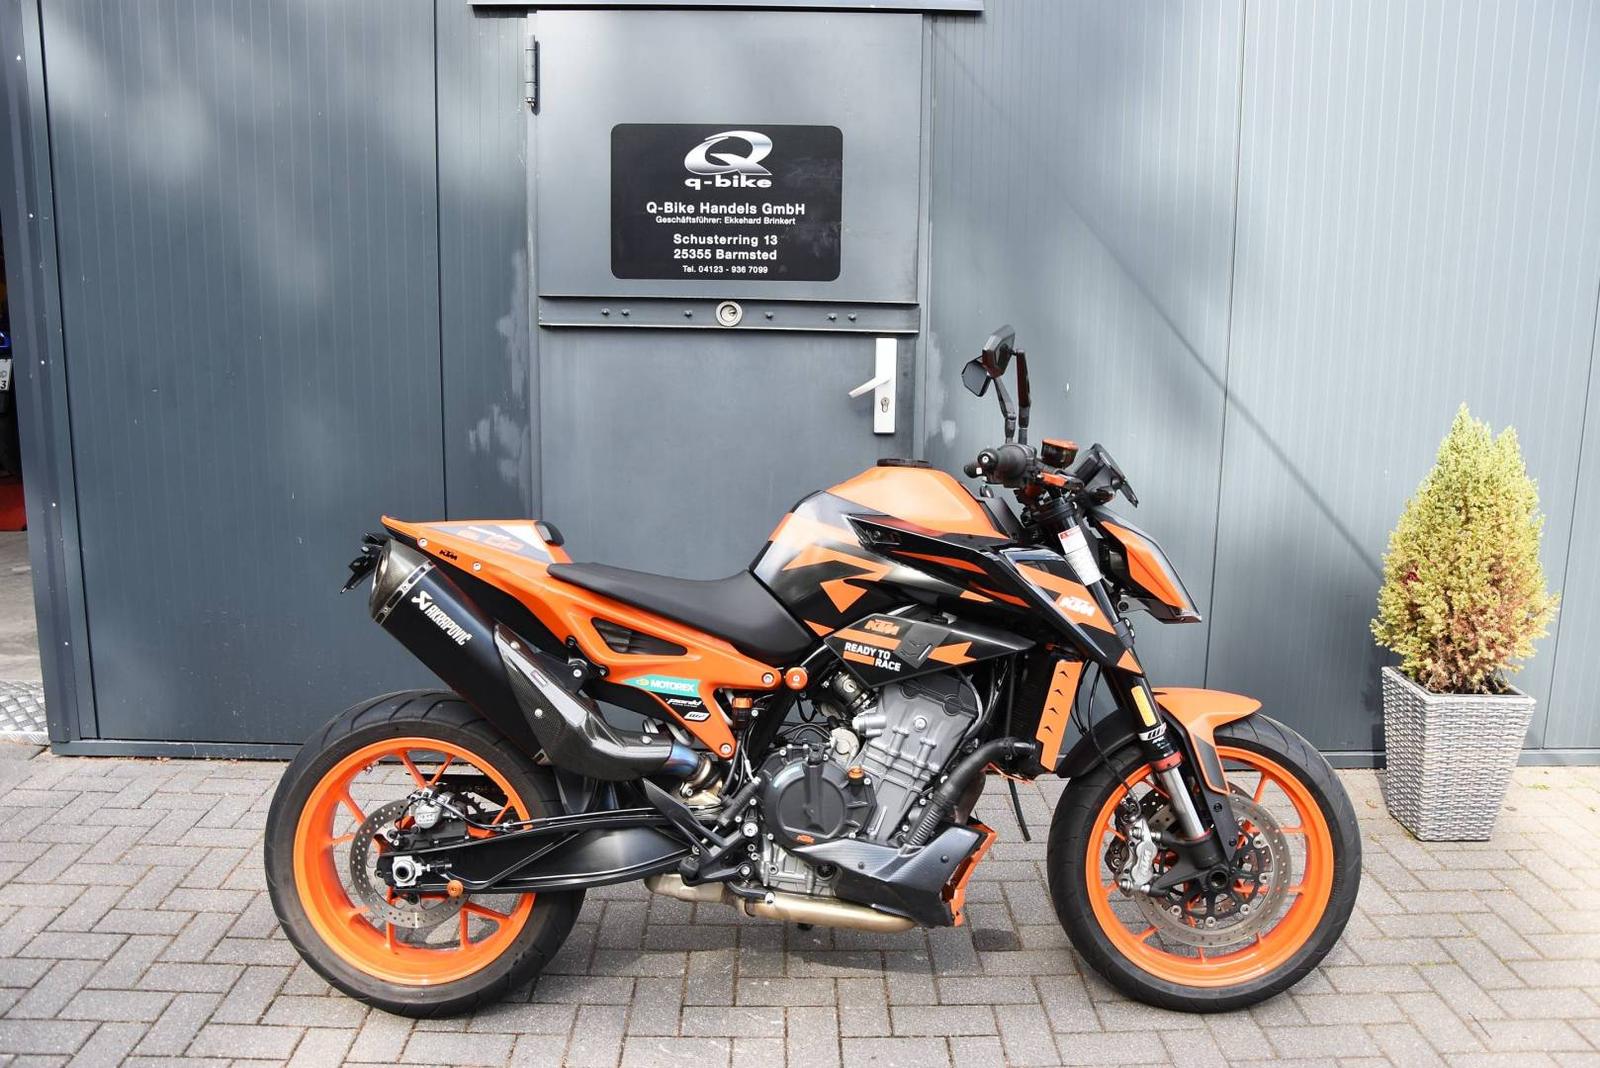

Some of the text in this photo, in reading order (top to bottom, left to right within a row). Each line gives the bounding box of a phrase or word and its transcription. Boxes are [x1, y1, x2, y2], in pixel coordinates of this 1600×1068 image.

[684, 174, 772, 190] q-bike
[646, 202, 805, 215] Q-Bike Handels GmbH
[655, 215, 796, 225] Geschäftsführer: Ekkehard Brinkert
[673, 233, 778, 248] Schusterring 13
[673, 249, 777, 261] 25355 Barmsted
[682, 265, 696, 273] Tel.
[698, 265, 723, 273] 04123
[748, 266, 768, 274] 7099
[439, 549, 458, 561] KTM
[1059, 596, 1096, 617] KTM
[864, 618, 900, 636] KTM
[844, 642, 891, 661] READY TO
[875, 659, 901, 672] RACE
[651, 680, 695, 692] MOTOREX
